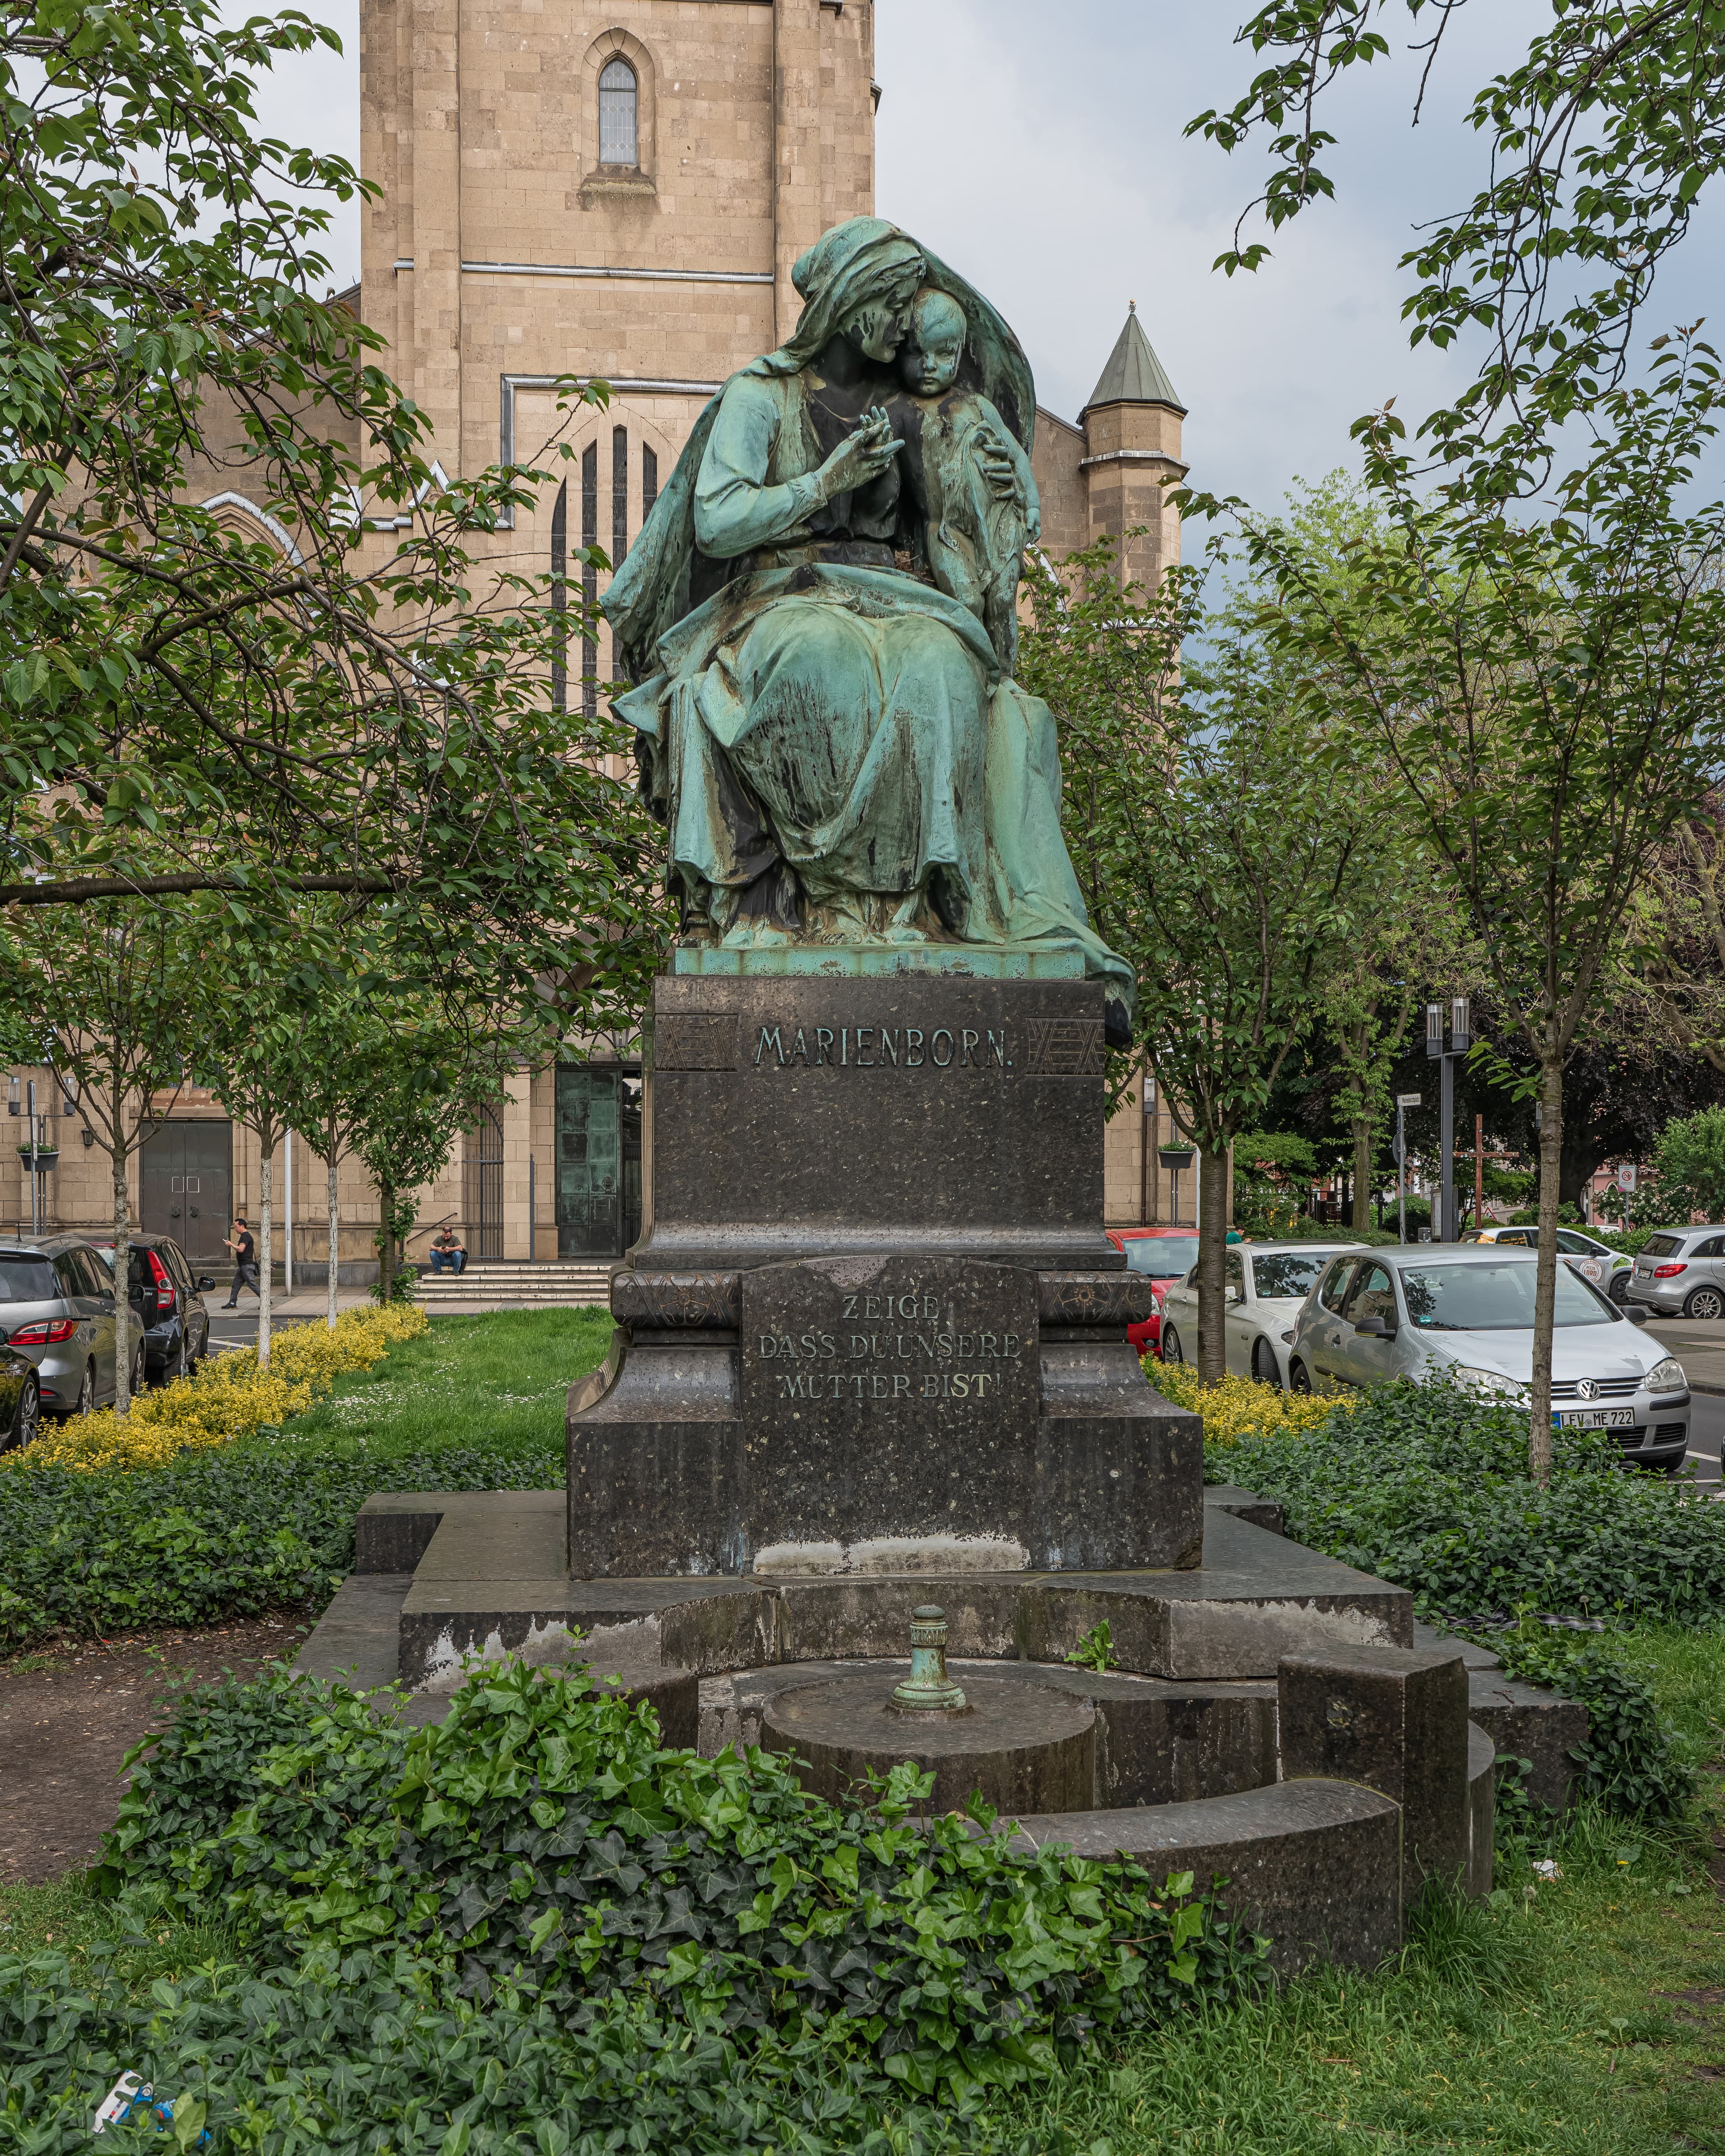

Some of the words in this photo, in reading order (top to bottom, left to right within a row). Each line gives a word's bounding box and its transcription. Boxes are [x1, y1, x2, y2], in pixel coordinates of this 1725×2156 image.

[842, 1295, 939, 1319] ZEIGE
[758, 1334, 836, 1359] DASS
[849, 1335, 889, 1358] DU
[896, 1334, 1022, 1358] UNSERE
[780, 1374, 914, 1398] MUTTER
[1561, 1414, 1584, 1427] LEV
[1593, 1412, 1608, 1426] ME
[1611, 1411, 1632, 1425] 722
